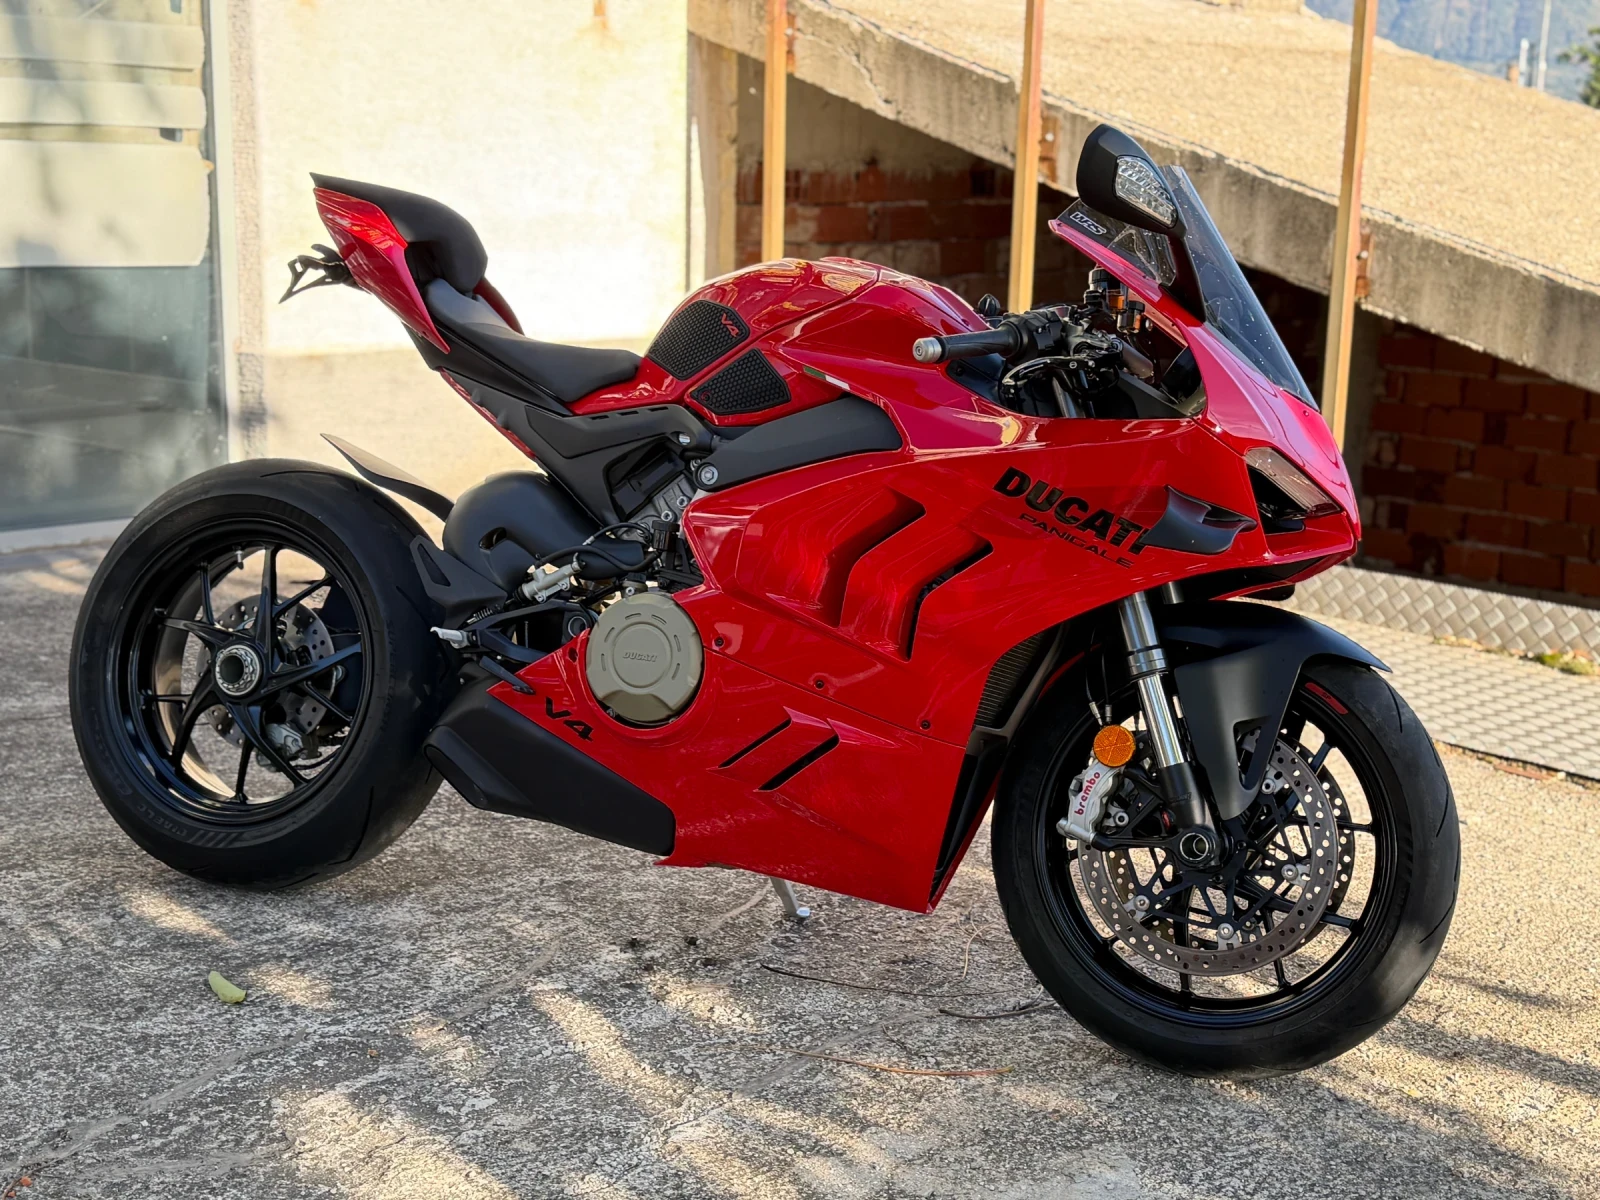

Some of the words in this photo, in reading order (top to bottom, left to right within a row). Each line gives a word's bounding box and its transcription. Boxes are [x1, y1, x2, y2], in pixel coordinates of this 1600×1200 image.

[721, 312, 740, 338] V4
[1019, 513, 1135, 569] PANIGALE
[622, 651, 658, 663] DUCATI
[545, 696, 595, 742] V4
[1074, 771, 1101, 816] brembo
